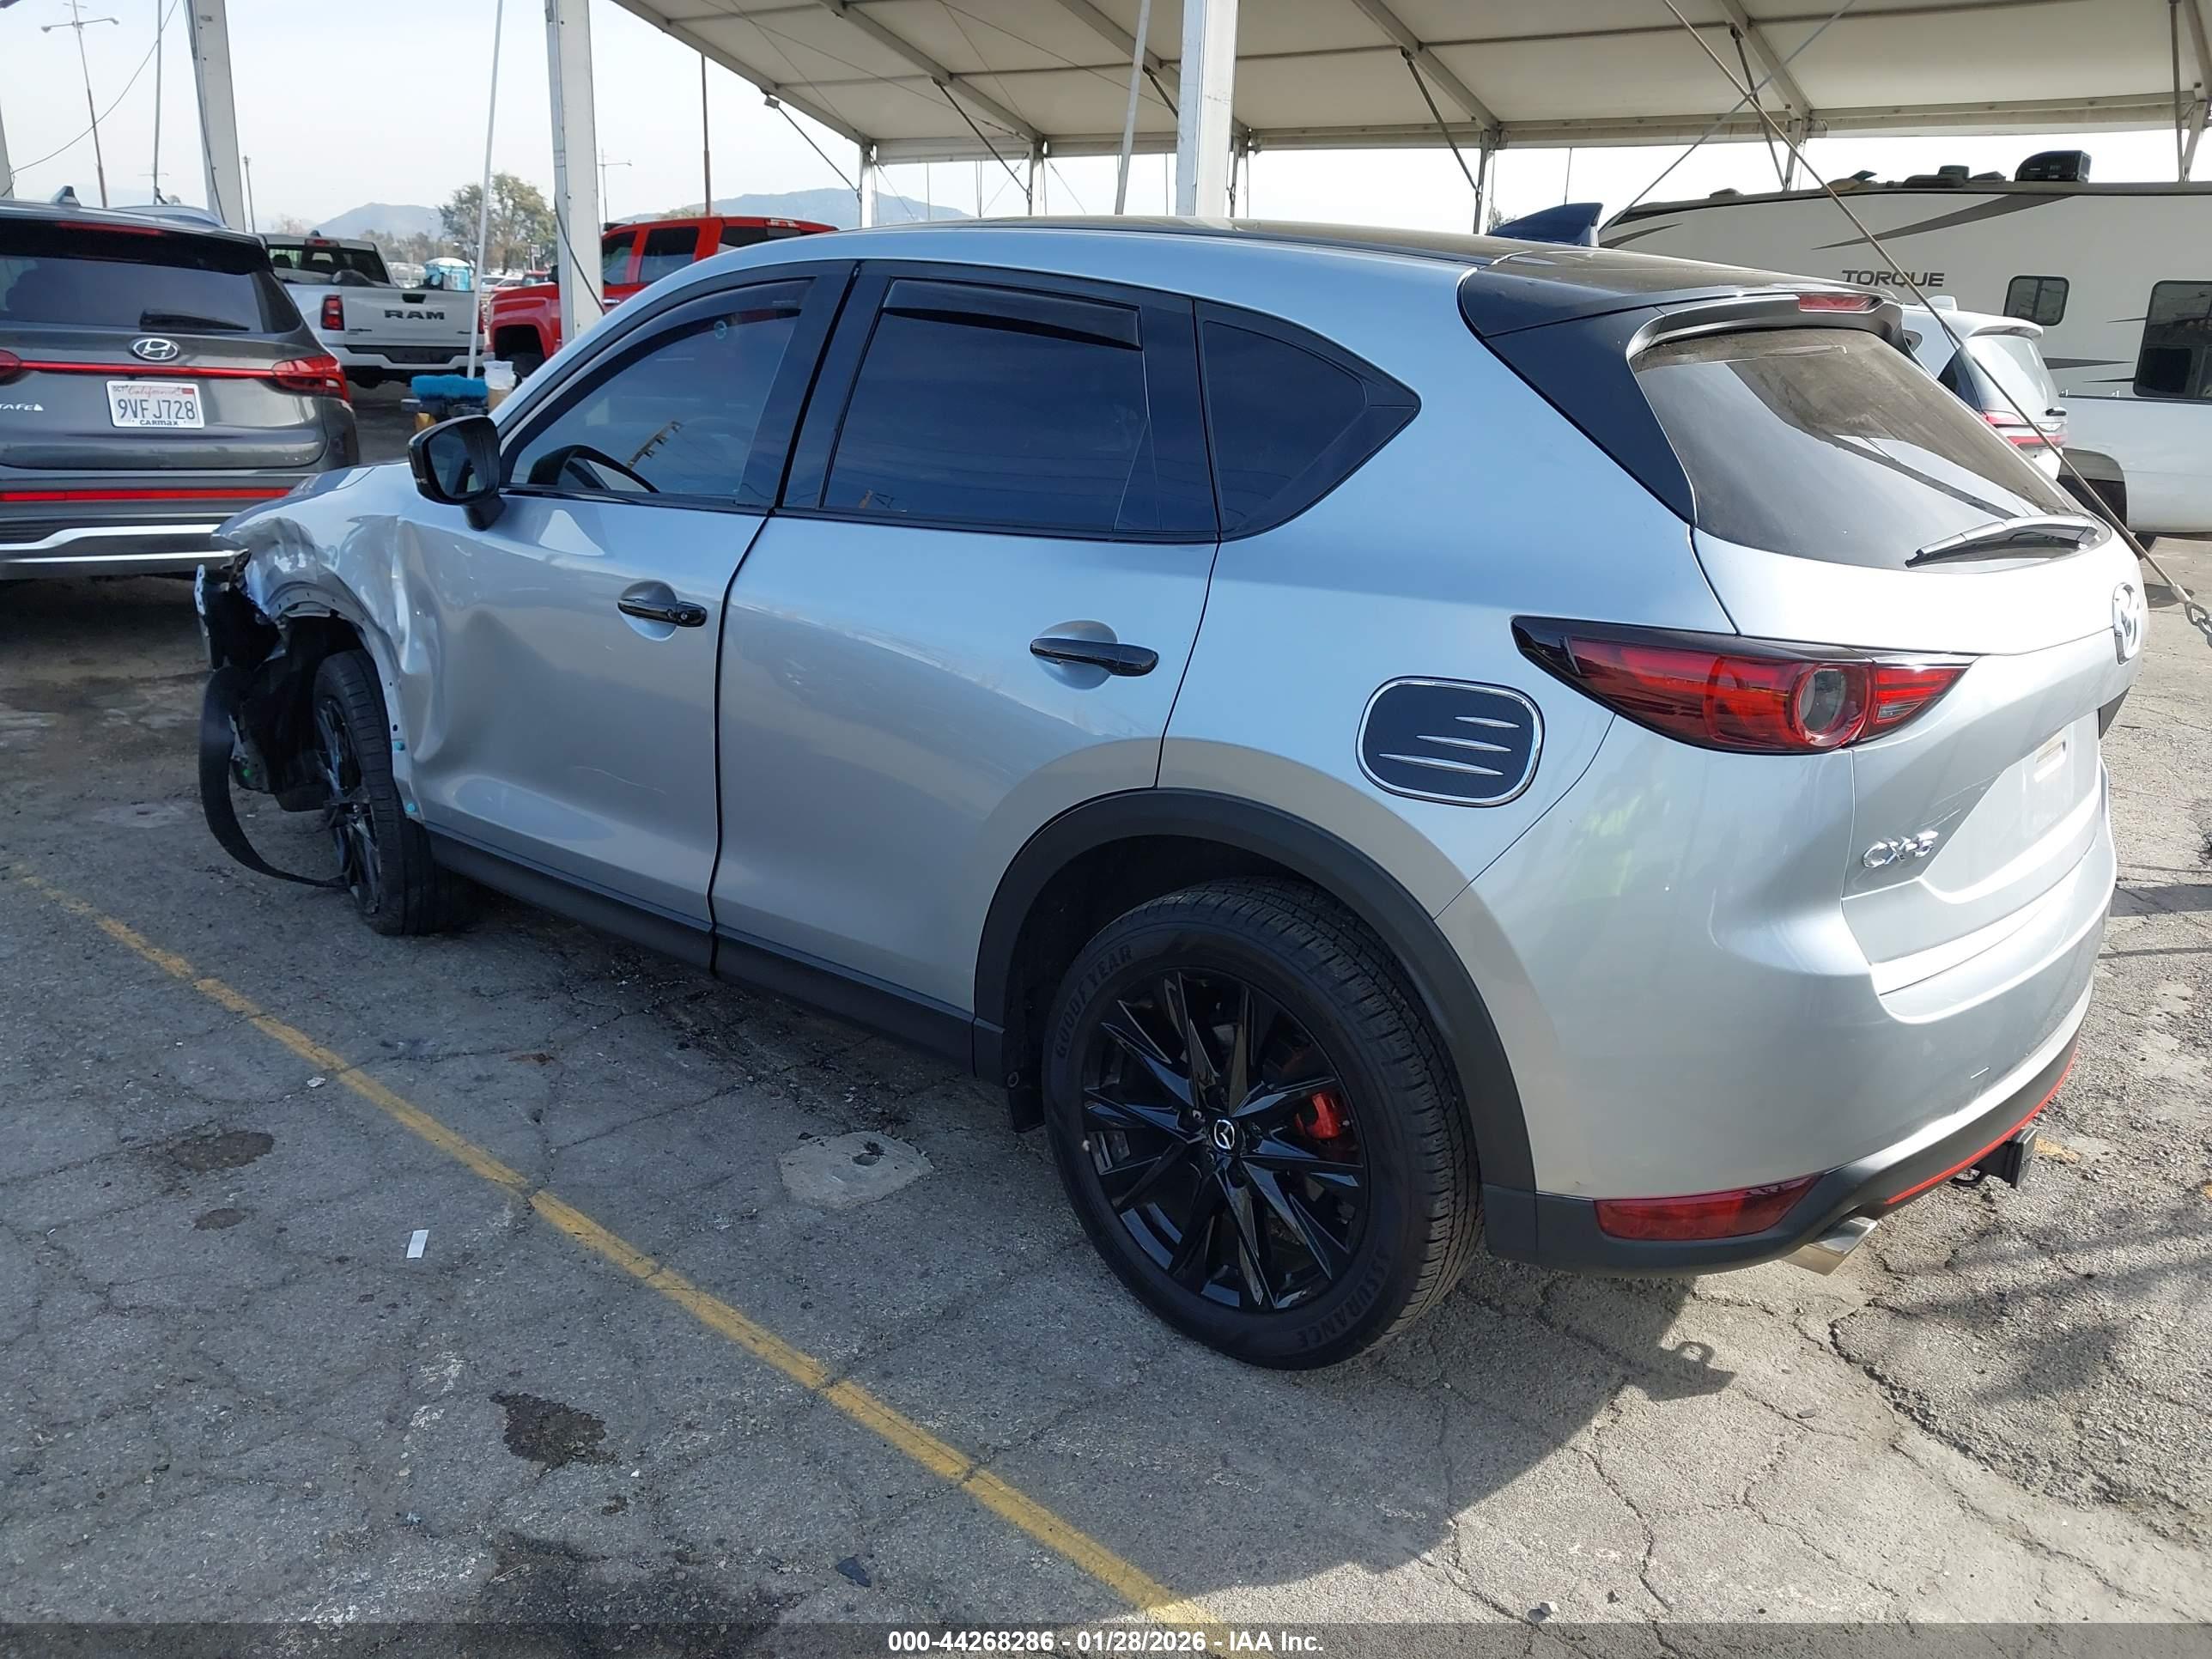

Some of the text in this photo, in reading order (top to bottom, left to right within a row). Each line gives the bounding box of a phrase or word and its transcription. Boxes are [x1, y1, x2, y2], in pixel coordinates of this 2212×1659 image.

[1841, 270, 1945, 288] TORQUE
[384, 309, 446, 320] RAM
[117, 398, 196, 420] 9VFJ728
[1862, 830, 1939, 868] CX-5
